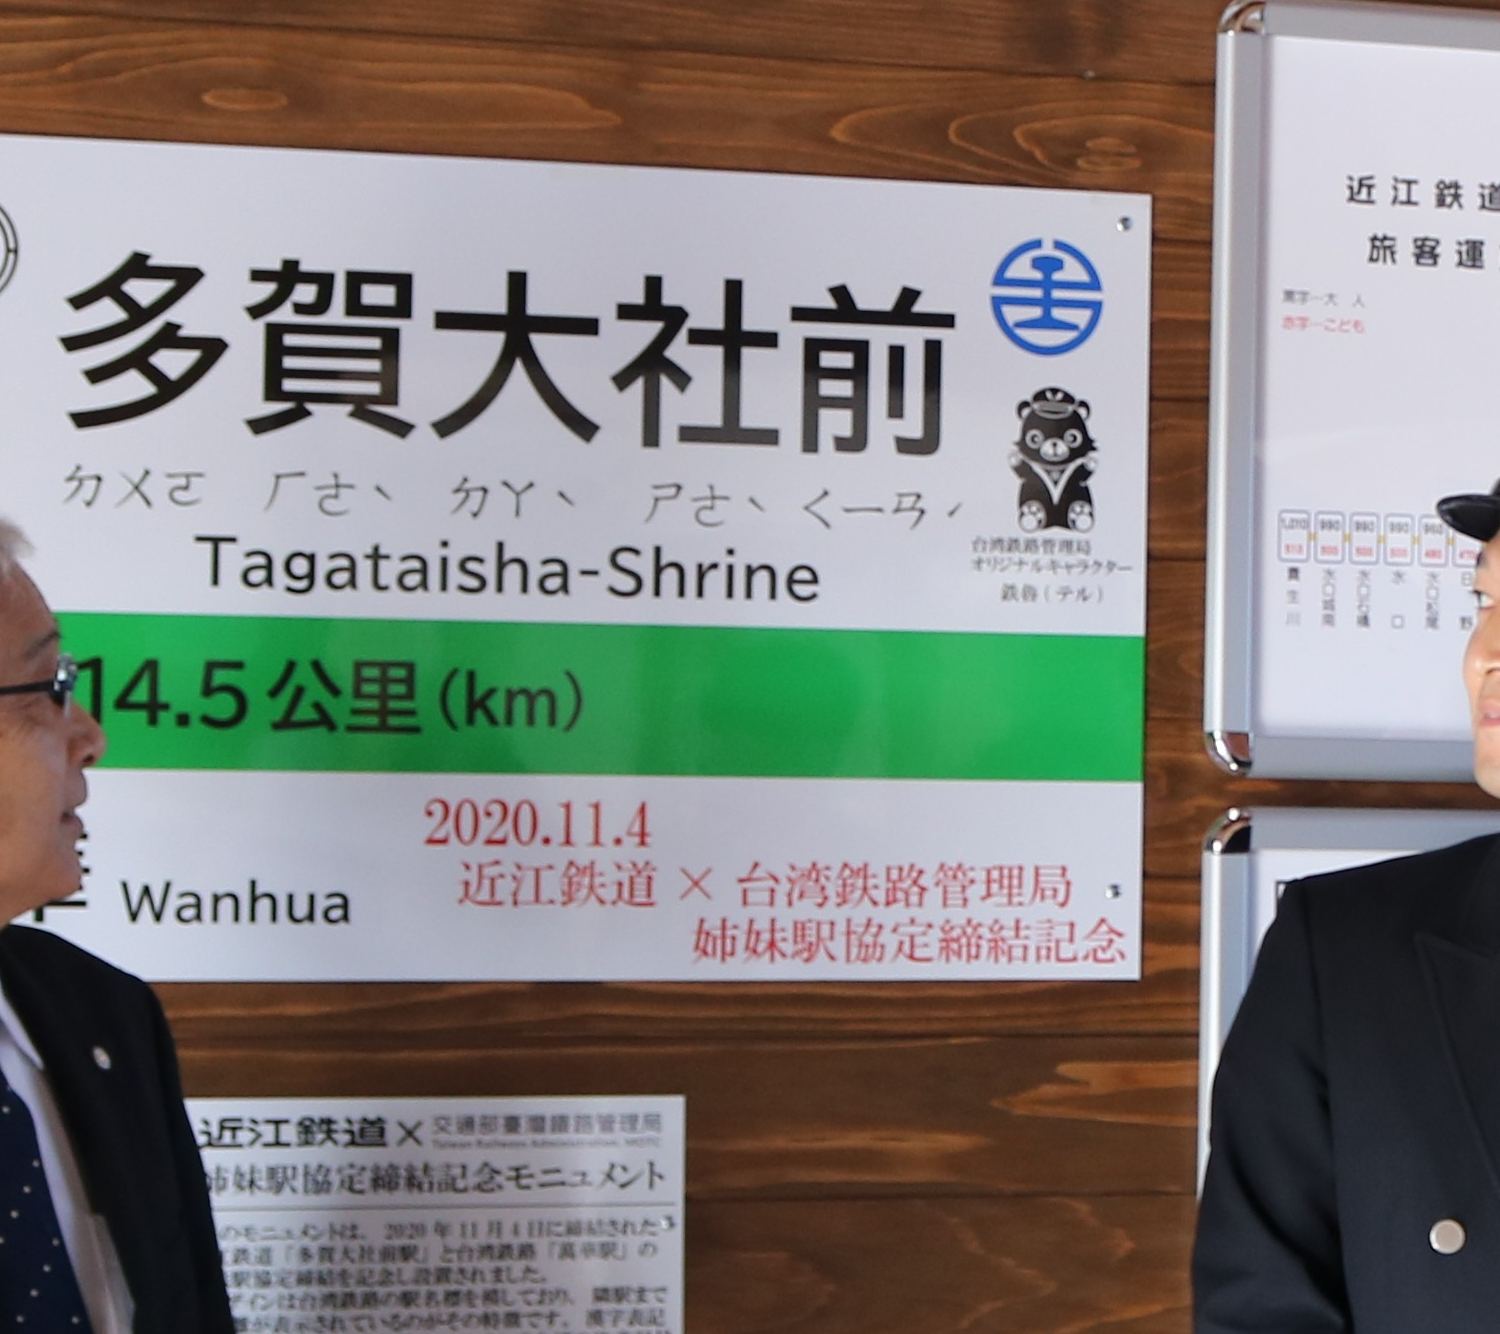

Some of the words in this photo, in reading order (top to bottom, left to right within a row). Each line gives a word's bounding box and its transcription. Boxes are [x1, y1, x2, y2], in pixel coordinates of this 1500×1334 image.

[57, 251, 957, 457] 多賀大社前
[195, 534, 820, 605] Tagataisha-Shrine
[423, 797, 652, 848] 2020.11.4
[120, 879, 351, 925] Wanhua
[457, 860, 658, 909] 近江鉄道
[736, 862, 1073, 910] 台湾鉄路管理局
[691, 917, 1128, 966] 姉妹駅協定締結記念
[198, 1116, 388, 1149] 近江鉄道
